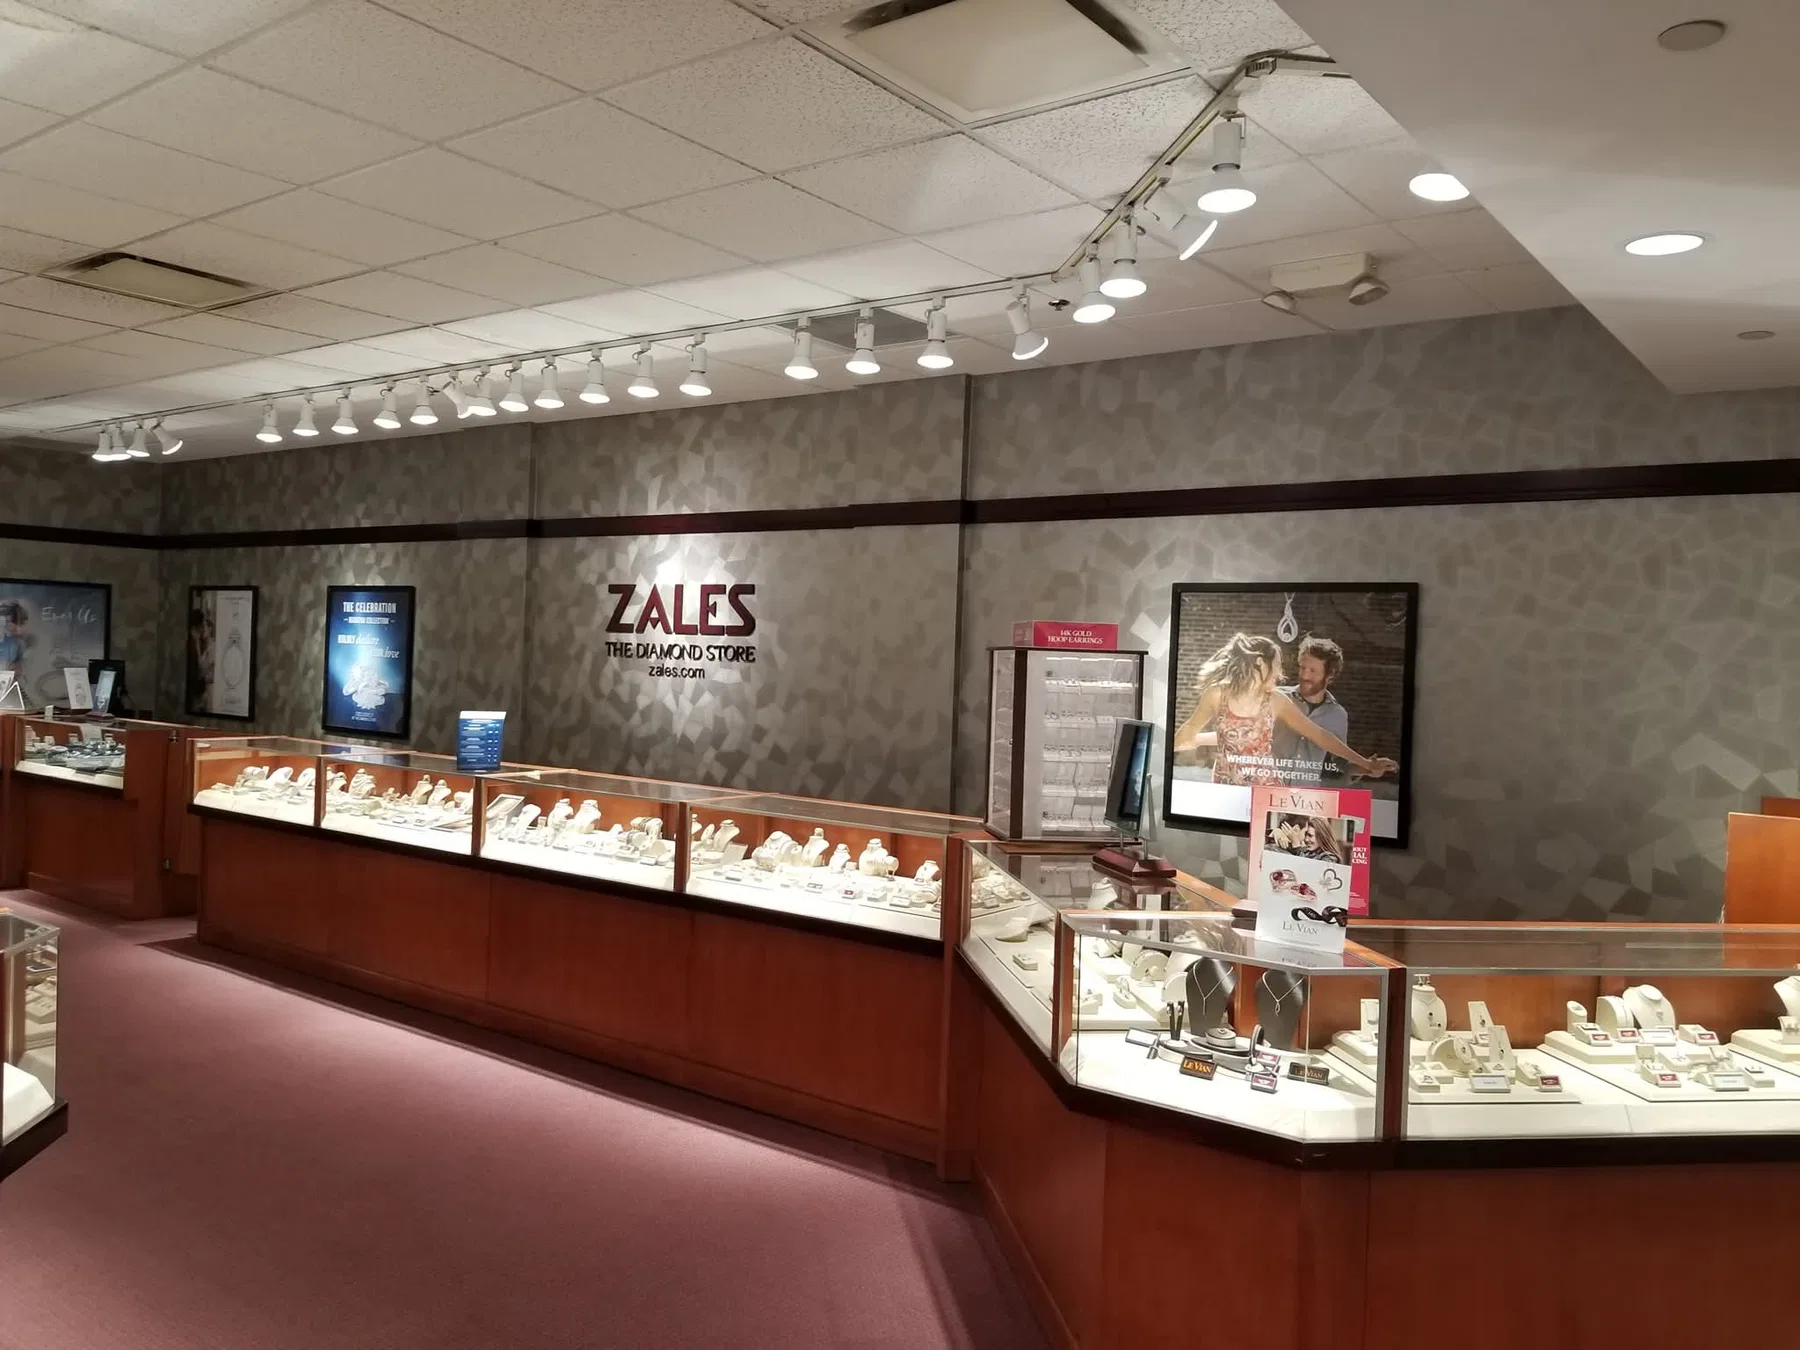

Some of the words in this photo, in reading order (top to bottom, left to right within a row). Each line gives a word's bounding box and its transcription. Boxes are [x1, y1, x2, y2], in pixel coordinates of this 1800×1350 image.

[343, 601, 355, 613] THE
[355, 602, 397, 614] CELEBRATION
[605, 583, 757, 637] ZALES
[1047, 635, 1068, 643] HOOP
[1068, 637, 1104, 645] EARRINGS
[604, 641, 634, 659] THE
[636, 642, 704, 661] DIAMOND
[705, 644, 757, 664] STORE
[648, 664, 706, 680] zales.com
[1226, 753, 1275, 767] WHEREVER
[1275, 758, 1294, 768] LIFE
[1294, 759, 1323, 771] TAKES
[1324, 762, 1340, 773] US,
[1241, 766, 1256, 776] WE
[1257, 768, 1272, 777] GO
[1272, 769, 1323, 782] TOGETHER.
